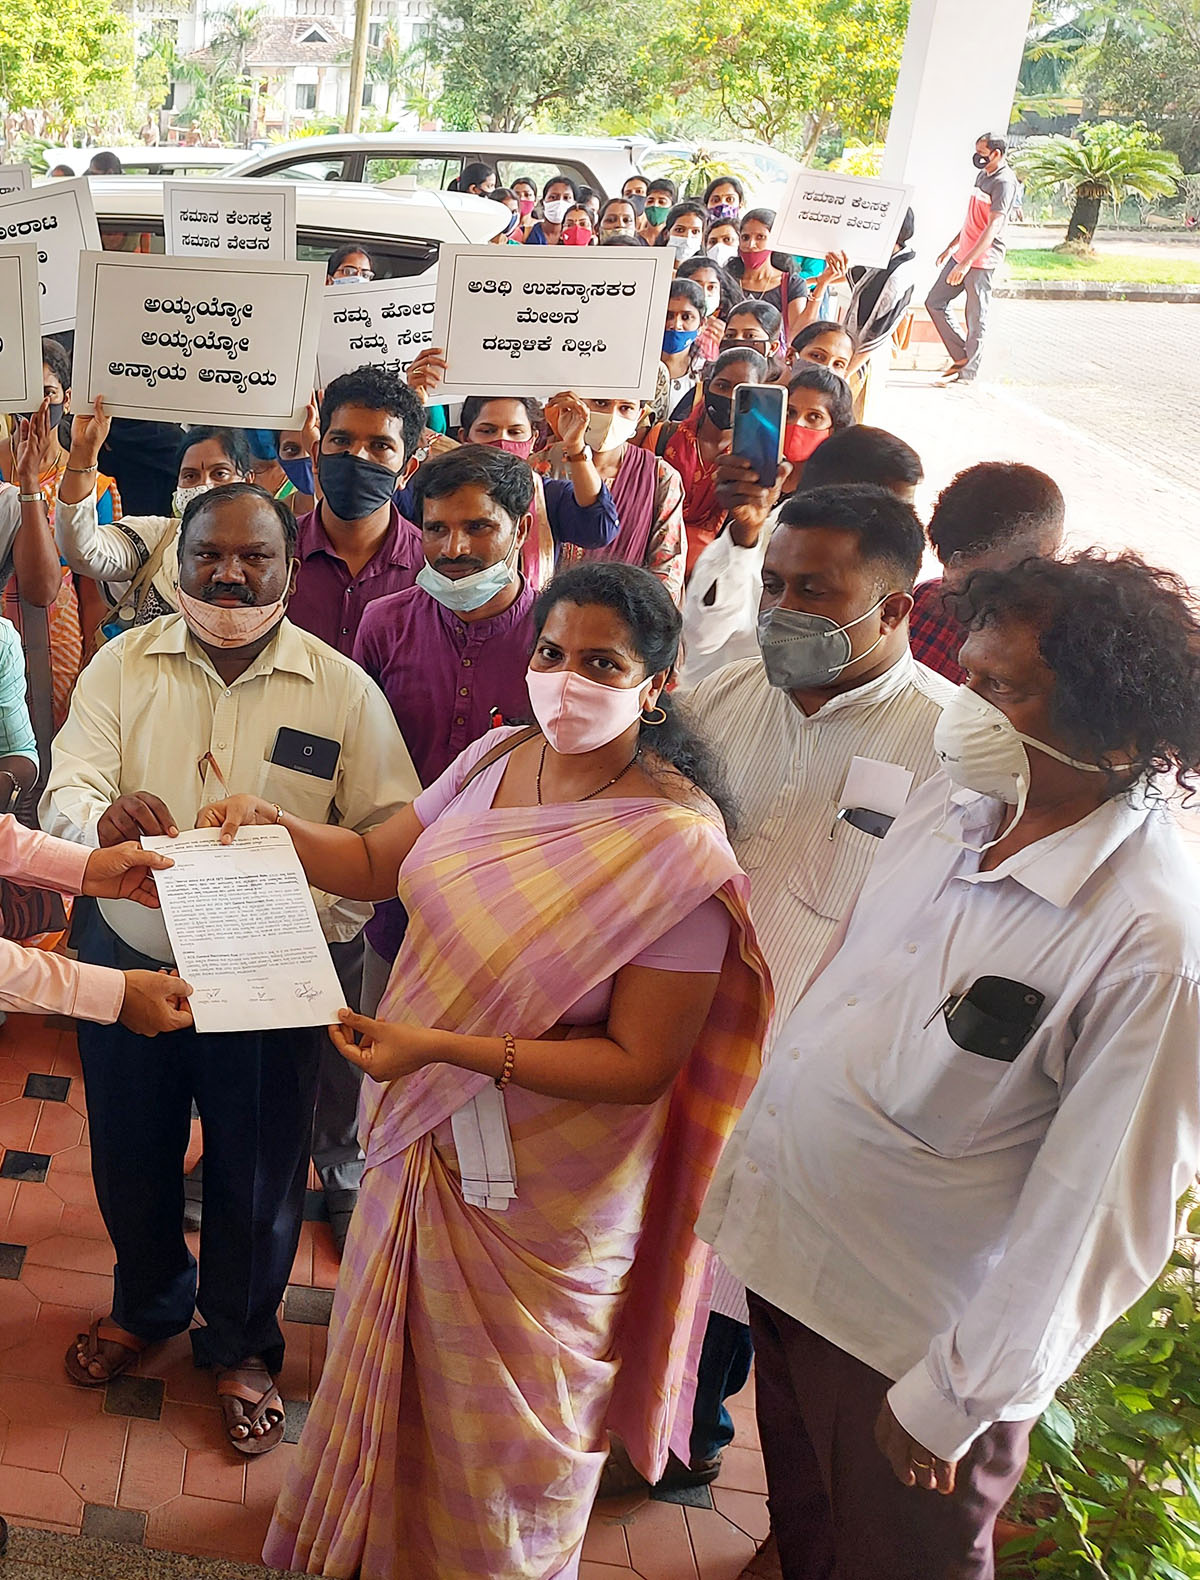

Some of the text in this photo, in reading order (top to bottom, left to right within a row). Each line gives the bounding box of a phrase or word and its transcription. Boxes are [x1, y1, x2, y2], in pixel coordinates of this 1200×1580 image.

[802, 189, 890, 218] ಸಮಾನ ಕೆಲಸಕ್ಕೆ
[180, 208, 272, 232] ಸಮಾನ ಕೆಲಸಕ್ಕೆ
[798, 209, 881, 231] ಸಮಾನ ವೇತನ
[182, 233, 270, 250] ಸಮಾನ ವೇತನ
[467, 279, 637, 304] ಅತಿಥಿ ಉಪನ್ಯಾಸಕರ
[144, 295, 253, 327] ಅಯ್ಯಯ್ಯೋ
[333, 301, 436, 328] ನಮ್ಮ ಹೋರ
[516, 306, 580, 324] ಮೇಲಿನ
[141, 329, 250, 360] ಅಯ್ಯಯ್ಯೋ
[349, 328, 433, 354] ನಮ್ಮ ಸೇವ
[482, 335, 608, 359] ದಬ್ಬಾಳಿಕೆ ನಿಲ್ಲಿಸಿ
[108, 361, 277, 394] ಅನ್ಯಾಯ ಅನ್ಯಾಯ
